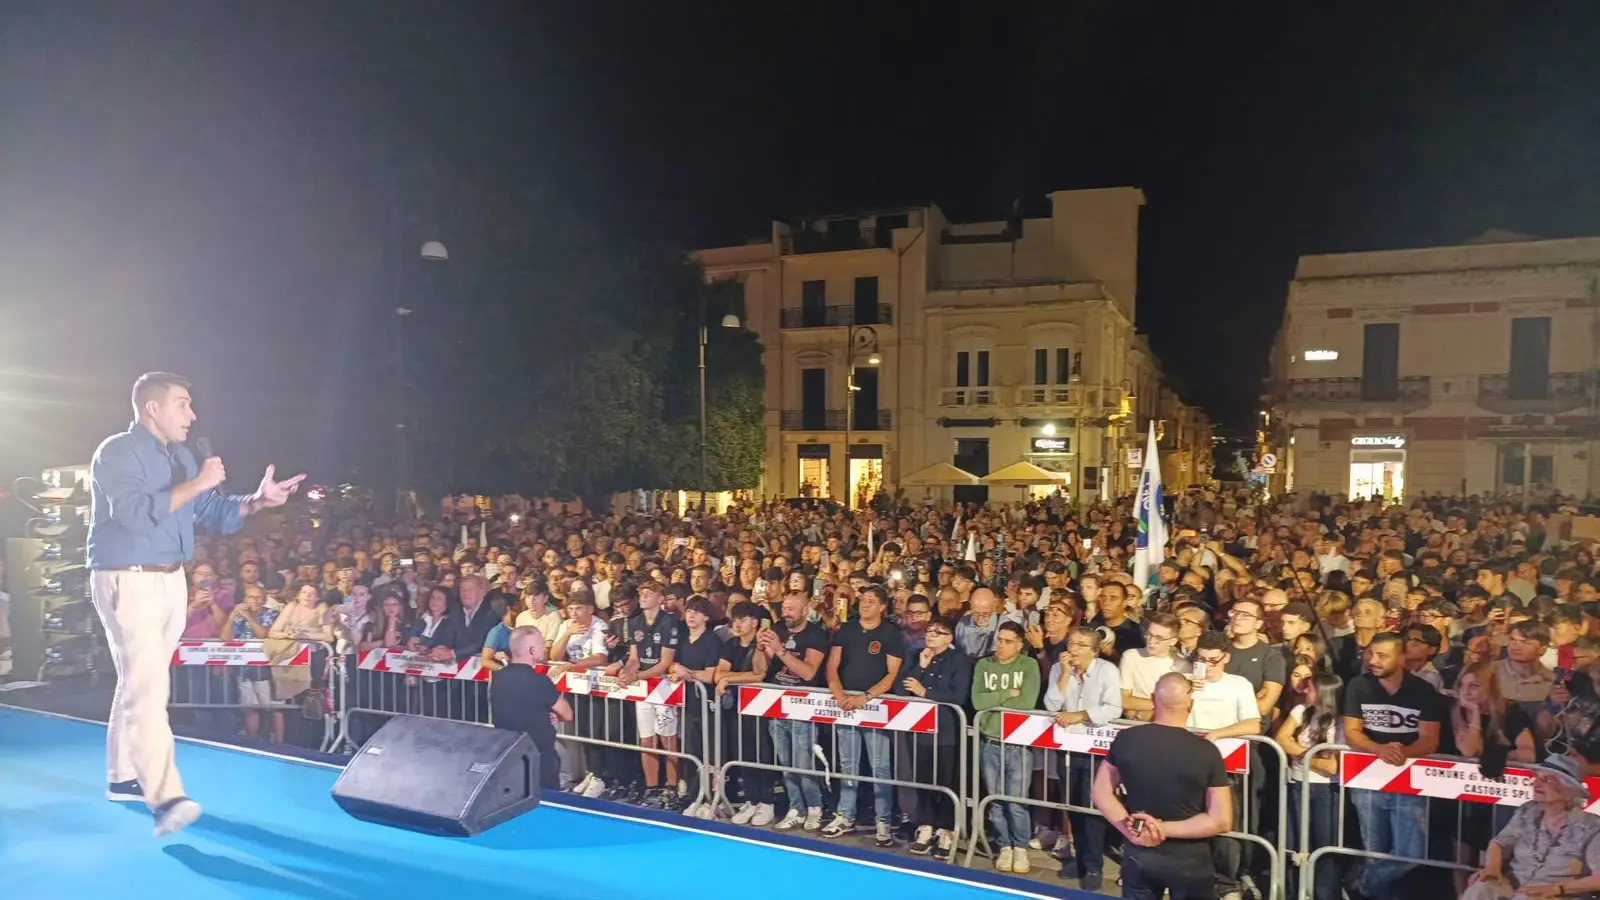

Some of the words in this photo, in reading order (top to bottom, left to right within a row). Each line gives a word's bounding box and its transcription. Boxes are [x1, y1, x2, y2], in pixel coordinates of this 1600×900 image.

[984, 671, 1024, 690] ICON
[790, 697, 815, 706] COMUNE
[814, 708, 841, 717] CASTORE
[1425, 768, 1465, 780] COMUNE
[1464, 784, 1508, 797] CASTORE
[1512, 789, 1531, 800] SPL
